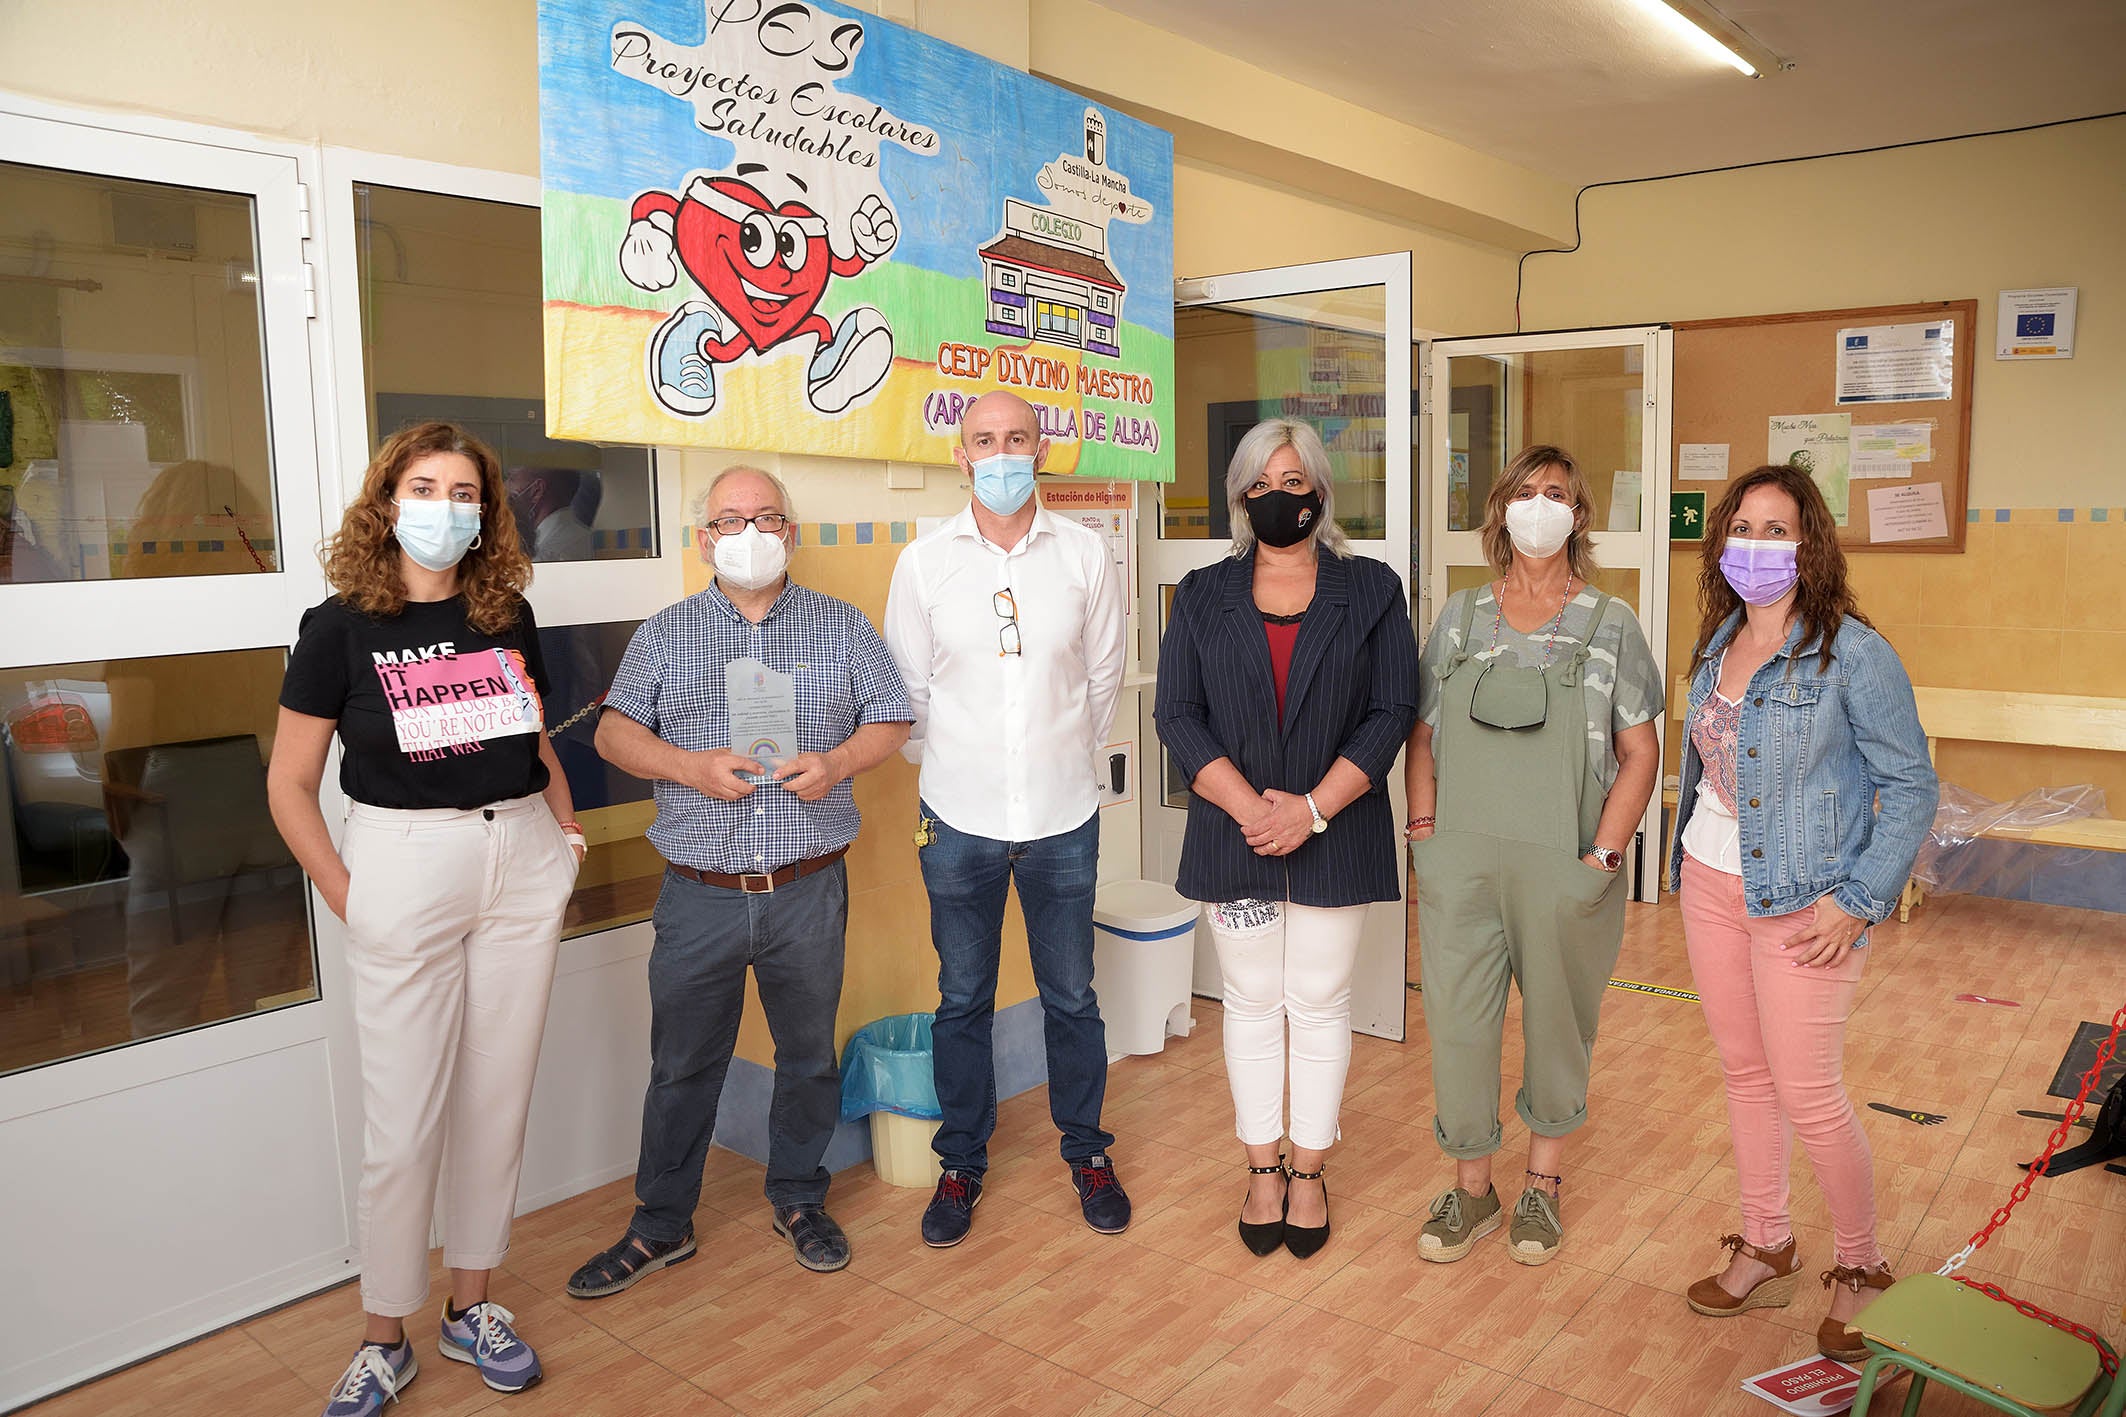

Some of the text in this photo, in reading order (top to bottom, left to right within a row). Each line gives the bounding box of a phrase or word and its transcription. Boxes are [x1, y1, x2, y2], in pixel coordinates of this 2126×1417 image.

[711, 0, 864, 71] PES
[612, 31, 937, 150] Proyectos Escolares
[698, 99, 878, 169] Saludables
[1037, 165, 1087, 200] Somos
[1101, 175, 1127, 194] Mancha
[1031, 212, 1082, 242] COLEGIO
[938, 341, 1153, 405] CEIP DIVINO MAESTRO
[1084, 410, 1106, 441] DE
[1112, 415, 1160, 453] ALBA)
[1046, 491, 1127, 504] Estación de Higiene
[371, 641, 457, 670] MAKE
[381, 669, 408, 691] IT
[389, 675, 509, 710] HAPPEN
[398, 717, 460, 740] YOU'RE
[463, 711, 497, 735] NOT
[402, 735, 486, 763] THAT WAY
[1781, 1368, 1826, 1387] EL PASO
[1786, 1373, 1844, 1394] PROHIBIDO
